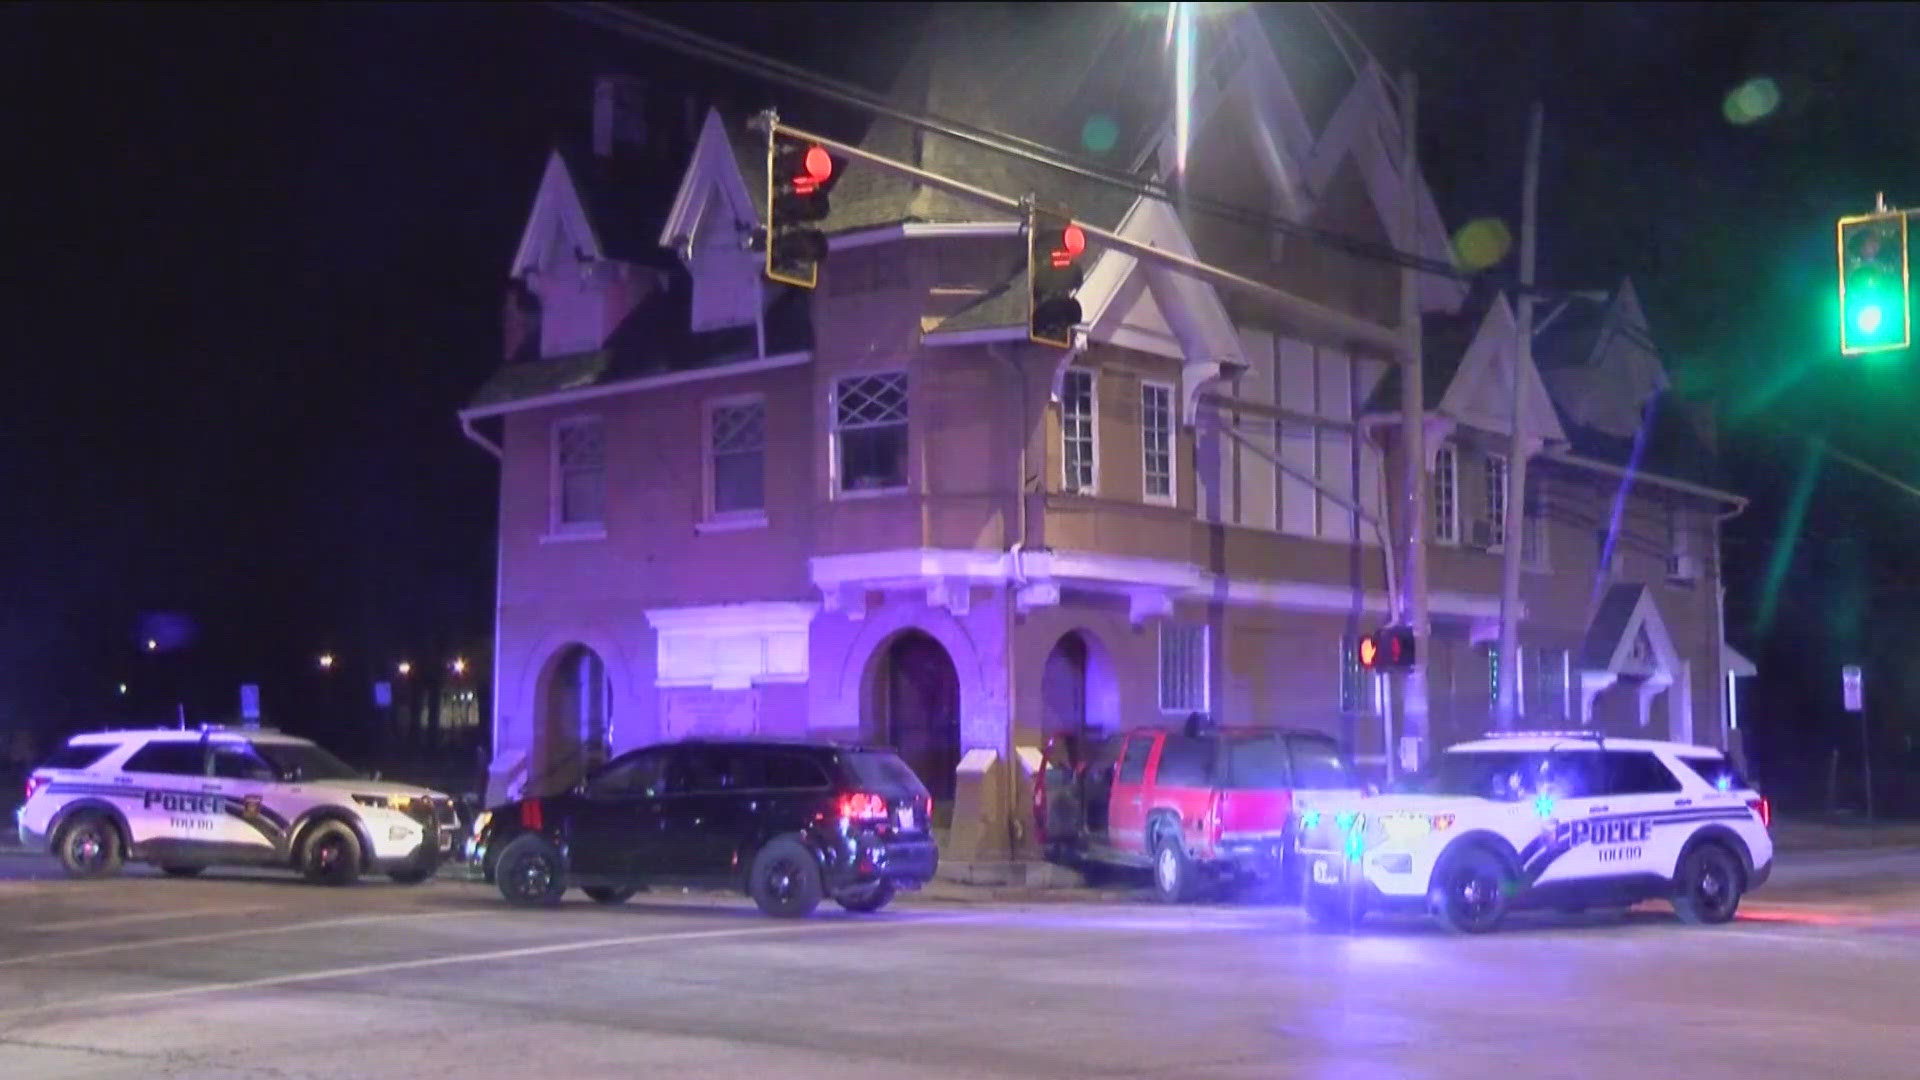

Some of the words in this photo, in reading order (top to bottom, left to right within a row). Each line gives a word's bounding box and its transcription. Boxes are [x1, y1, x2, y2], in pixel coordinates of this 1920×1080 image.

[144, 790, 226, 814] POLICE
[1571, 818, 1651, 846] POLICE
[1598, 846, 1642, 862] TOLEDO
